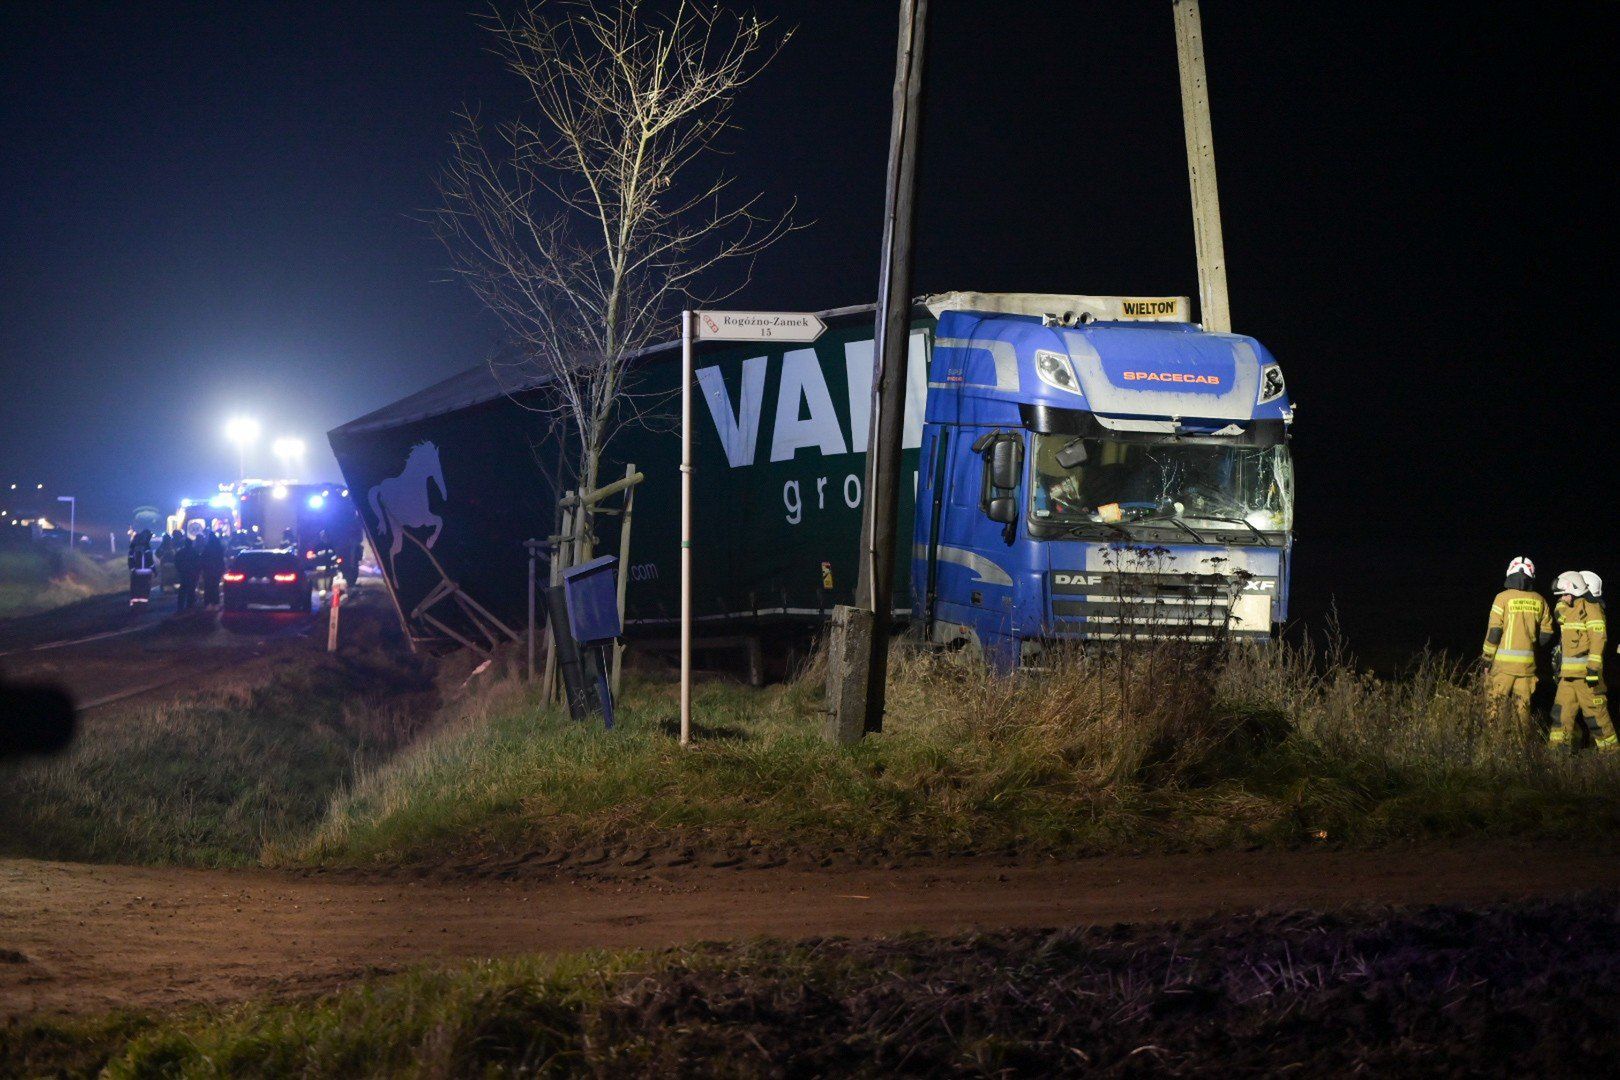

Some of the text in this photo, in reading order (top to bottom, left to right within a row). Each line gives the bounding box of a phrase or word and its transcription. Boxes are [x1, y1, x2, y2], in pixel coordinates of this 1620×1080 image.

[1123, 301, 1174, 315] WIELTON
[760, 328, 772, 337] 15
[1123, 371, 1220, 385] SPACECAB
[1054, 574, 1102, 586] DAF
[1243, 580, 1276, 591] XF
